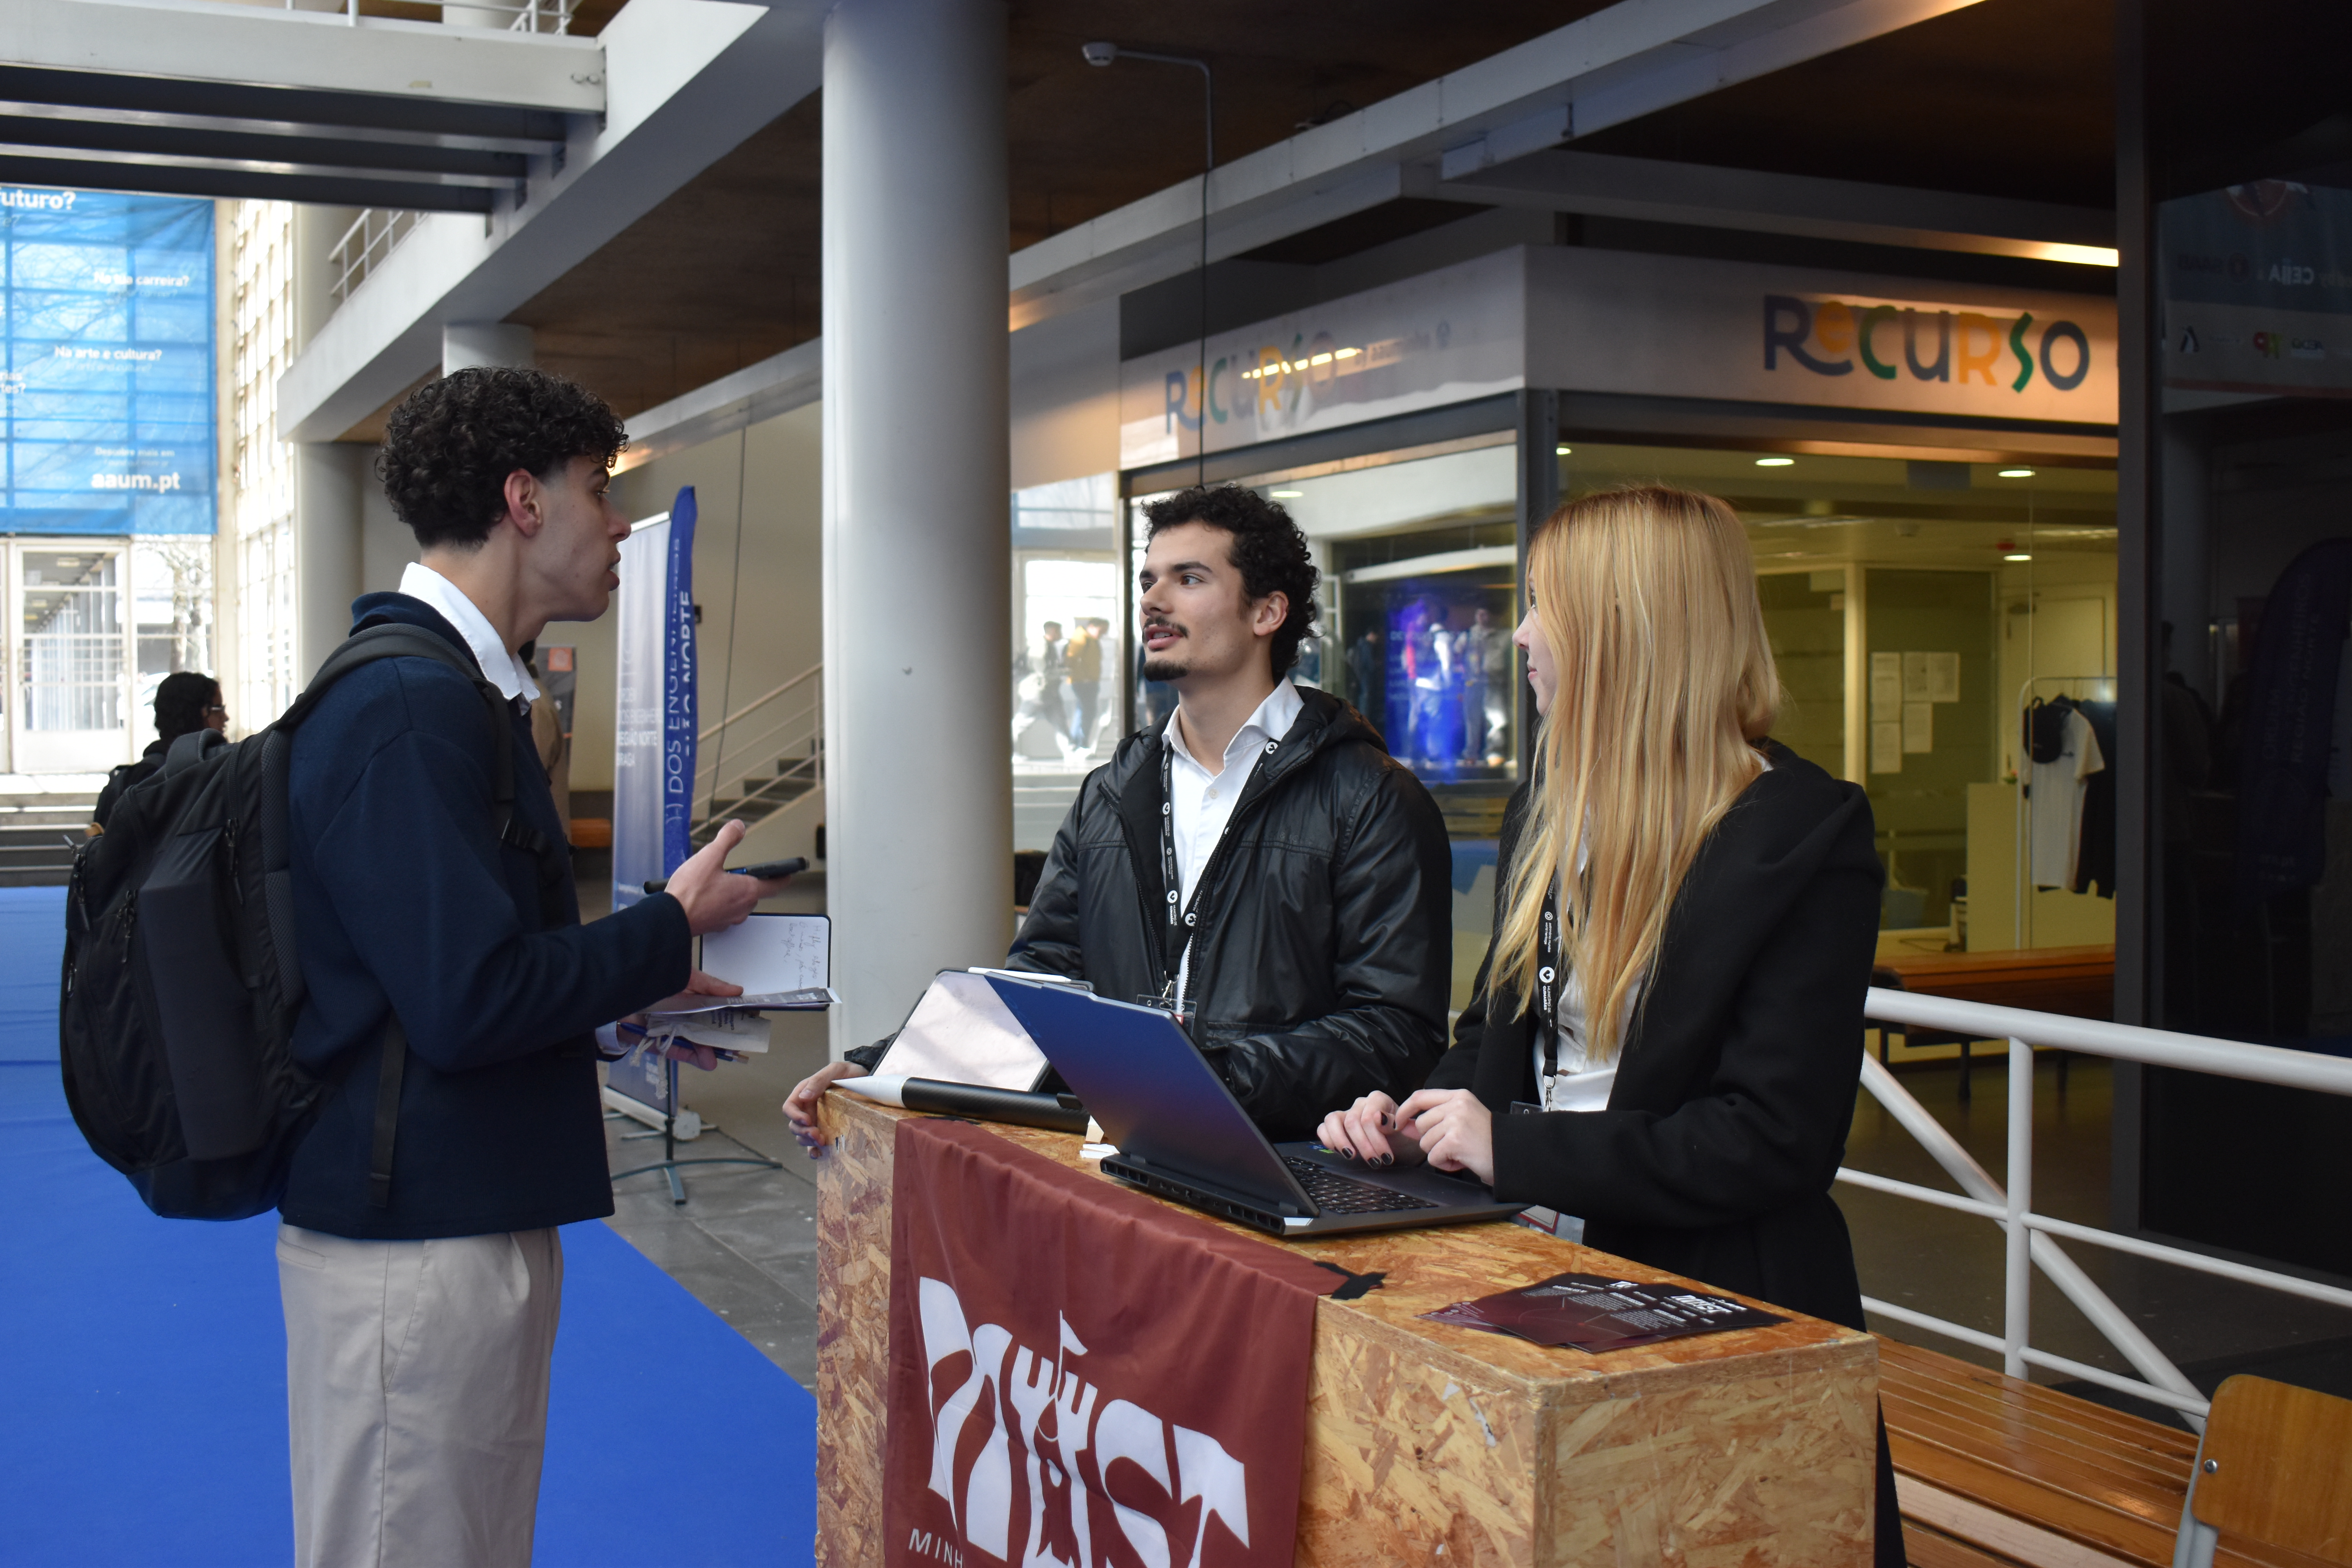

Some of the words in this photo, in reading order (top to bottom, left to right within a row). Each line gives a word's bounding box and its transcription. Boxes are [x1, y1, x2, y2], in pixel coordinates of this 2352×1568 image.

[0, 187, 76, 210] uturo?
[136, 275, 190, 287] carreira?
[54, 345, 73, 358] Na
[75, 347, 100, 359] arte
[113, 348, 162, 361] cultura?
[91, 472, 181, 494] aaum.pt
[909, 1528, 963, 1568] MINH
